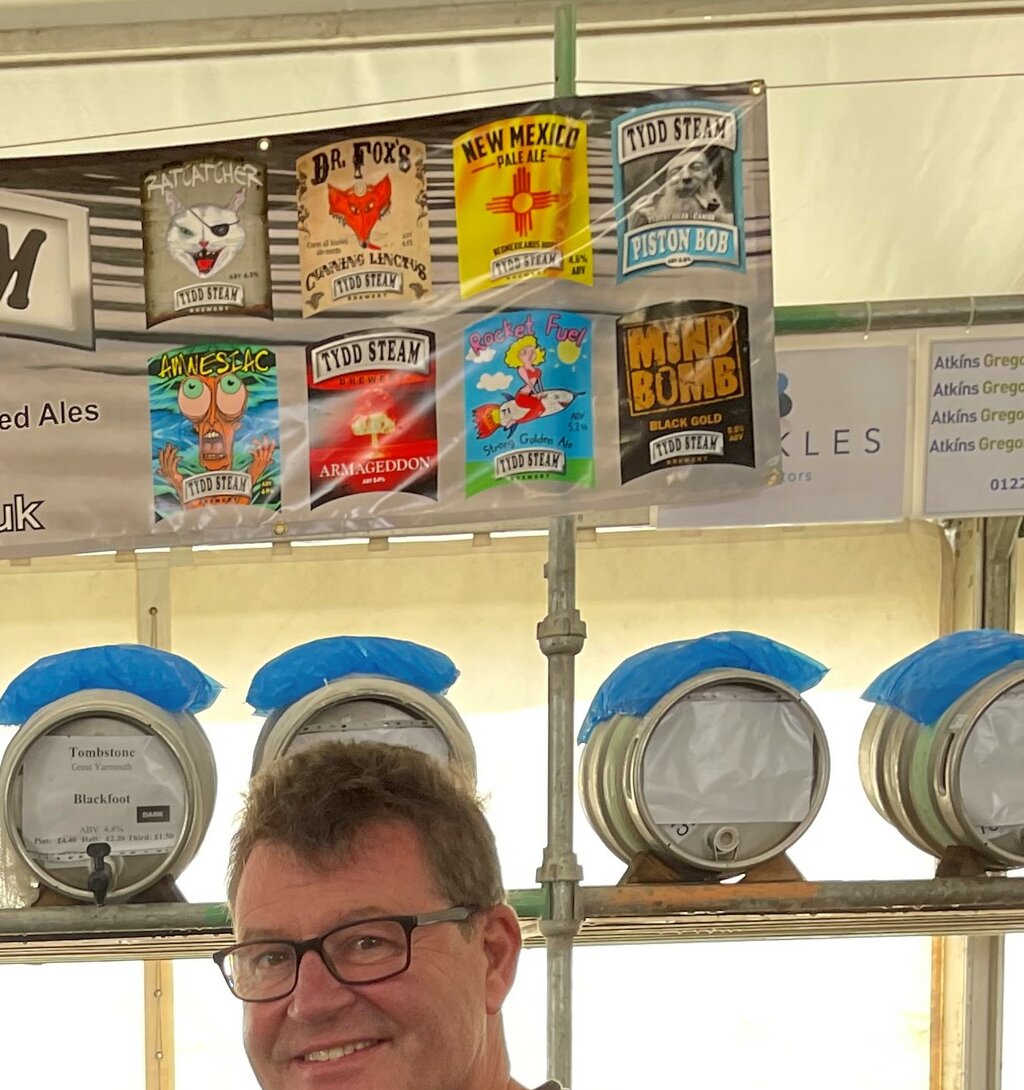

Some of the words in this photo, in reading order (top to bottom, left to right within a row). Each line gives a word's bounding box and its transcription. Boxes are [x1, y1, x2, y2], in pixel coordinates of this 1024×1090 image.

[461, 133, 504, 164] NEW
[510, 121, 580, 150] MEXICO
[627, 124, 667, 151] TYDD
[673, 117, 727, 140] STEAM
[311, 149, 346, 186] DR.
[496, 154, 524, 169] PALE
[526, 149, 547, 164] ALE
[144, 162, 264, 199] RATCATCHER
[631, 228, 691, 260] PISTON
[695, 228, 729, 253] BOB
[306, 254, 365, 292] CUNNING
[369, 252, 427, 281] LINCTUS
[496, 257, 521, 274] TYDD
[524, 253, 557, 268] STEAM
[179, 287, 204, 305] TYDD
[207, 286, 239, 301] STEAM
[336, 276, 362, 293] TYDD
[365, 273, 397, 289] STEAM
[469, 317, 535, 354] Rocket
[546, 313, 587, 348] Fuel
[628, 313, 734, 370] MIND
[158, 349, 269, 379] AMNESIAC
[321, 344, 362, 372] TYDD
[368, 339, 421, 365] STEAM
[630, 357, 740, 411] BOMB
[39, 400, 100, 428] Ales
[649, 417, 688, 431] BLACK
[691, 413, 722, 426] GOLD
[520, 433, 554, 445] Golden
[656, 438, 682, 457] TYDD
[685, 436, 718, 451] STEAM
[319, 456, 431, 478] ARMAGEDDON
[500, 454, 525, 473] TYDD
[528, 452, 560, 468] STEAM
[188, 477, 213, 496] TYDD
[216, 475, 247, 492] STEAM
[69, 746, 135, 758] Tombstone
[73, 793, 130, 804] Blackfoot
